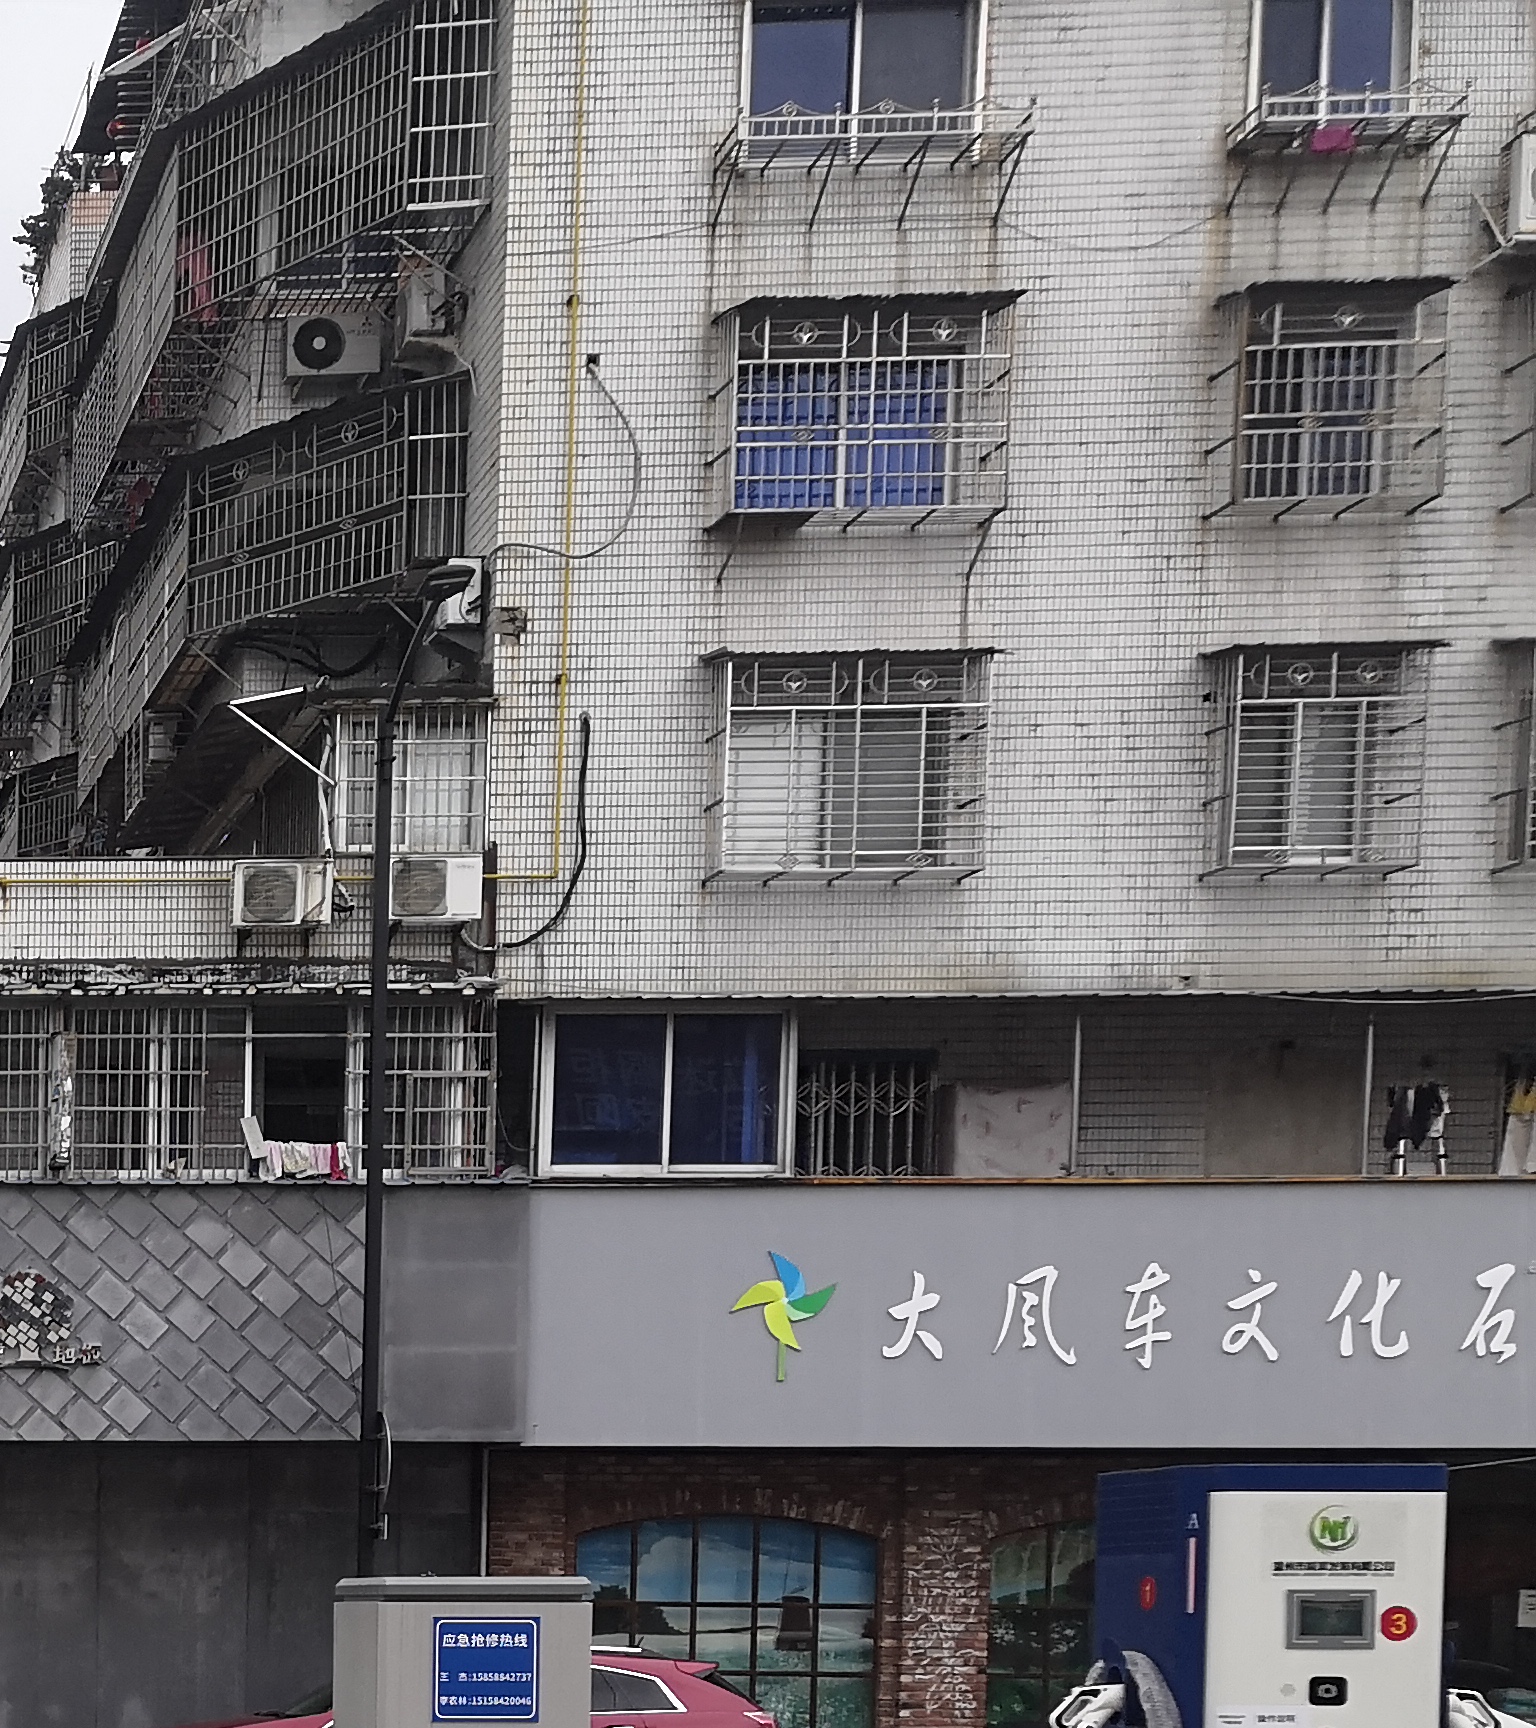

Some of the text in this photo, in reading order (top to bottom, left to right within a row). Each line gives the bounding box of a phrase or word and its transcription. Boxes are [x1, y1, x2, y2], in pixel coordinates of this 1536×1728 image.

[1187, 1512, 1200, 1530] A
[442, 1633, 529, 1648] 应急抢修热线
